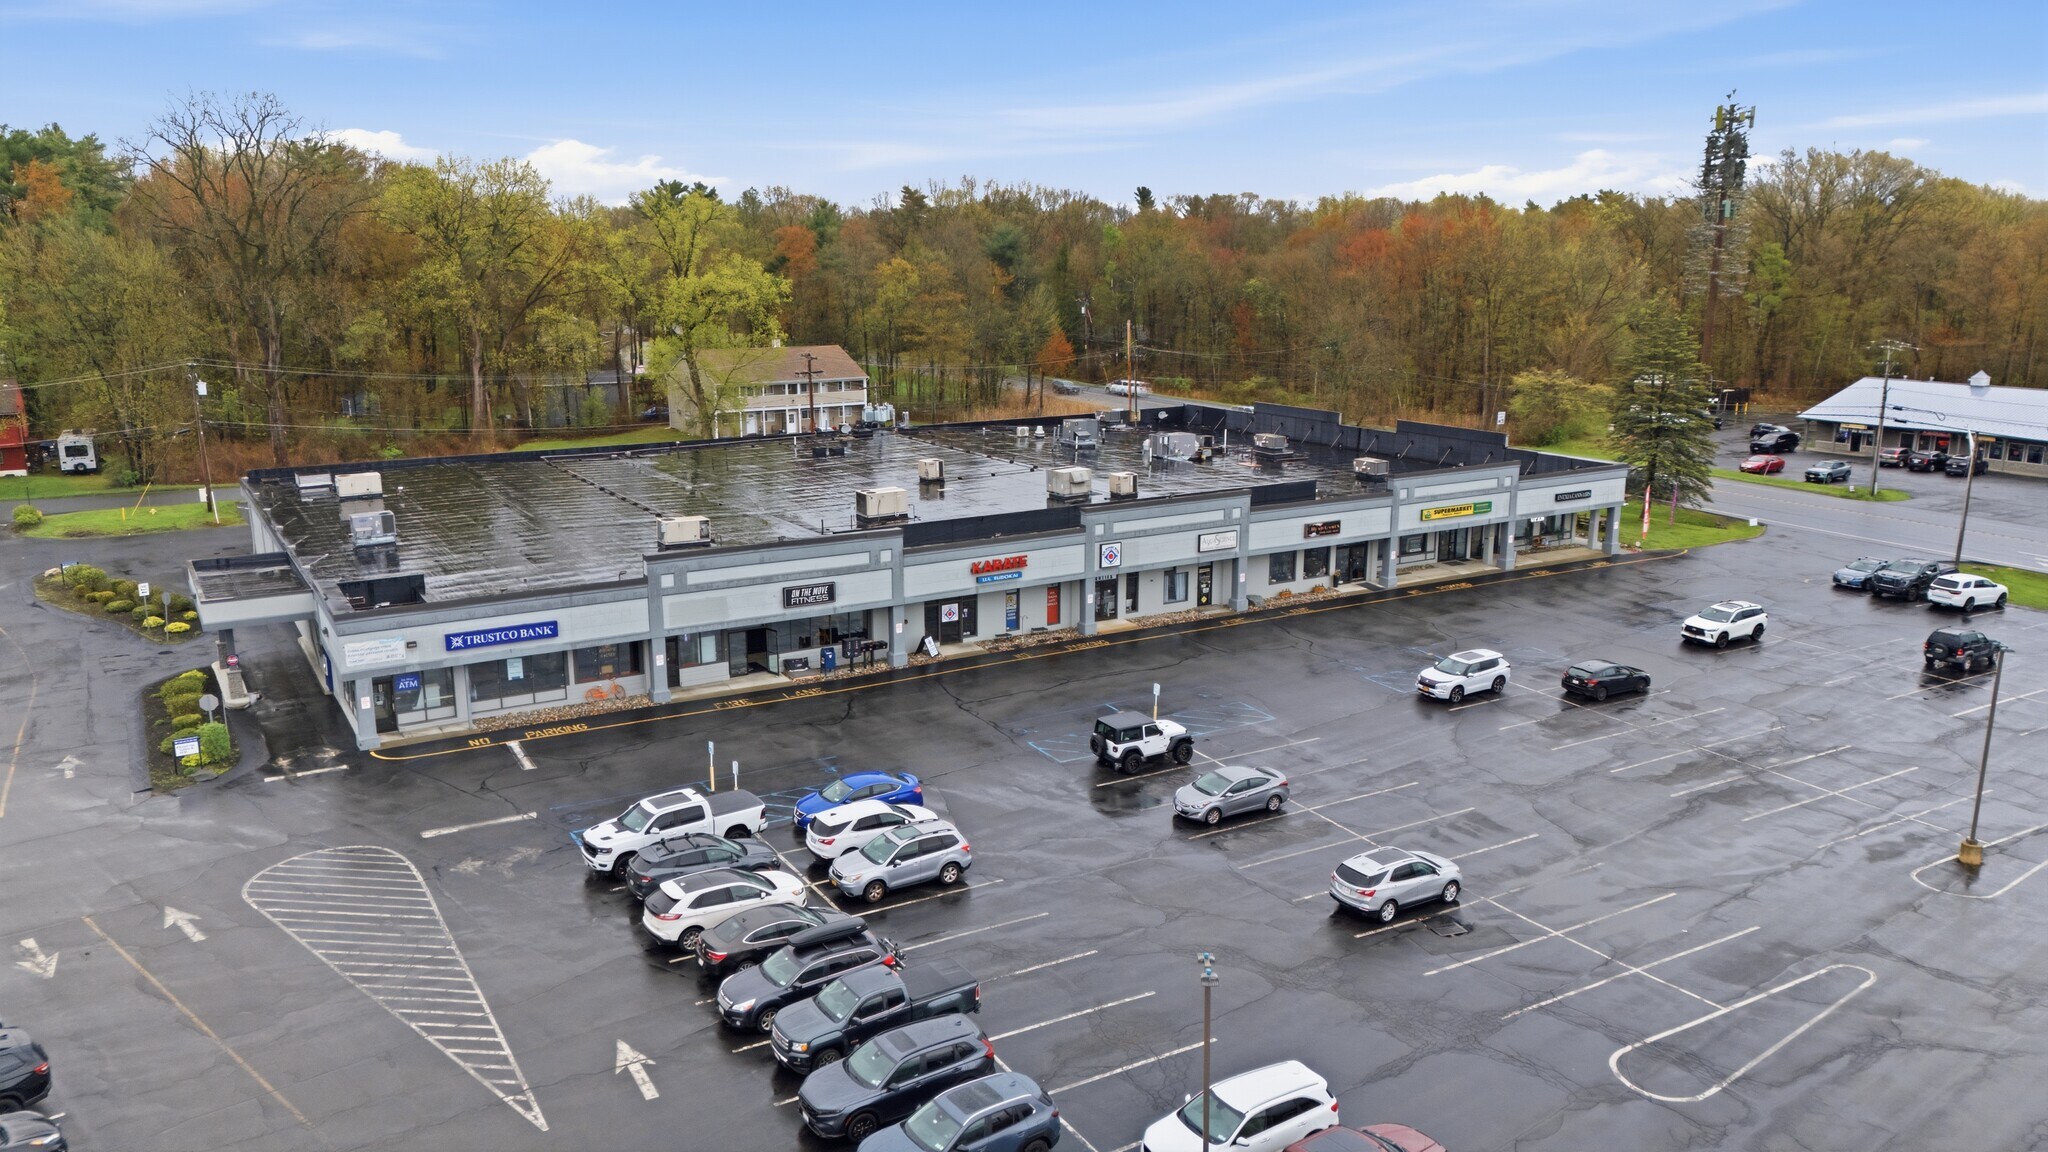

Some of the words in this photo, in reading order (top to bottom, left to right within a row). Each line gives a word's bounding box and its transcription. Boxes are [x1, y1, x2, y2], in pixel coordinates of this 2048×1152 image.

[1433, 505, 1473, 515] SUPERMARKET
[971, 555, 1028, 574] KARATE
[791, 589, 801, 598] ON
[801, 587, 812, 597] THE
[812, 585, 829, 596] MOVE
[791, 594, 829, 605] FITNESS
[464, 630, 518, 646] TRUSTCO
[519, 626, 553, 639] BANK
[398, 680, 419, 690] ATM
[468, 737, 491, 747] NO
[525, 723, 588, 740] PARKING
